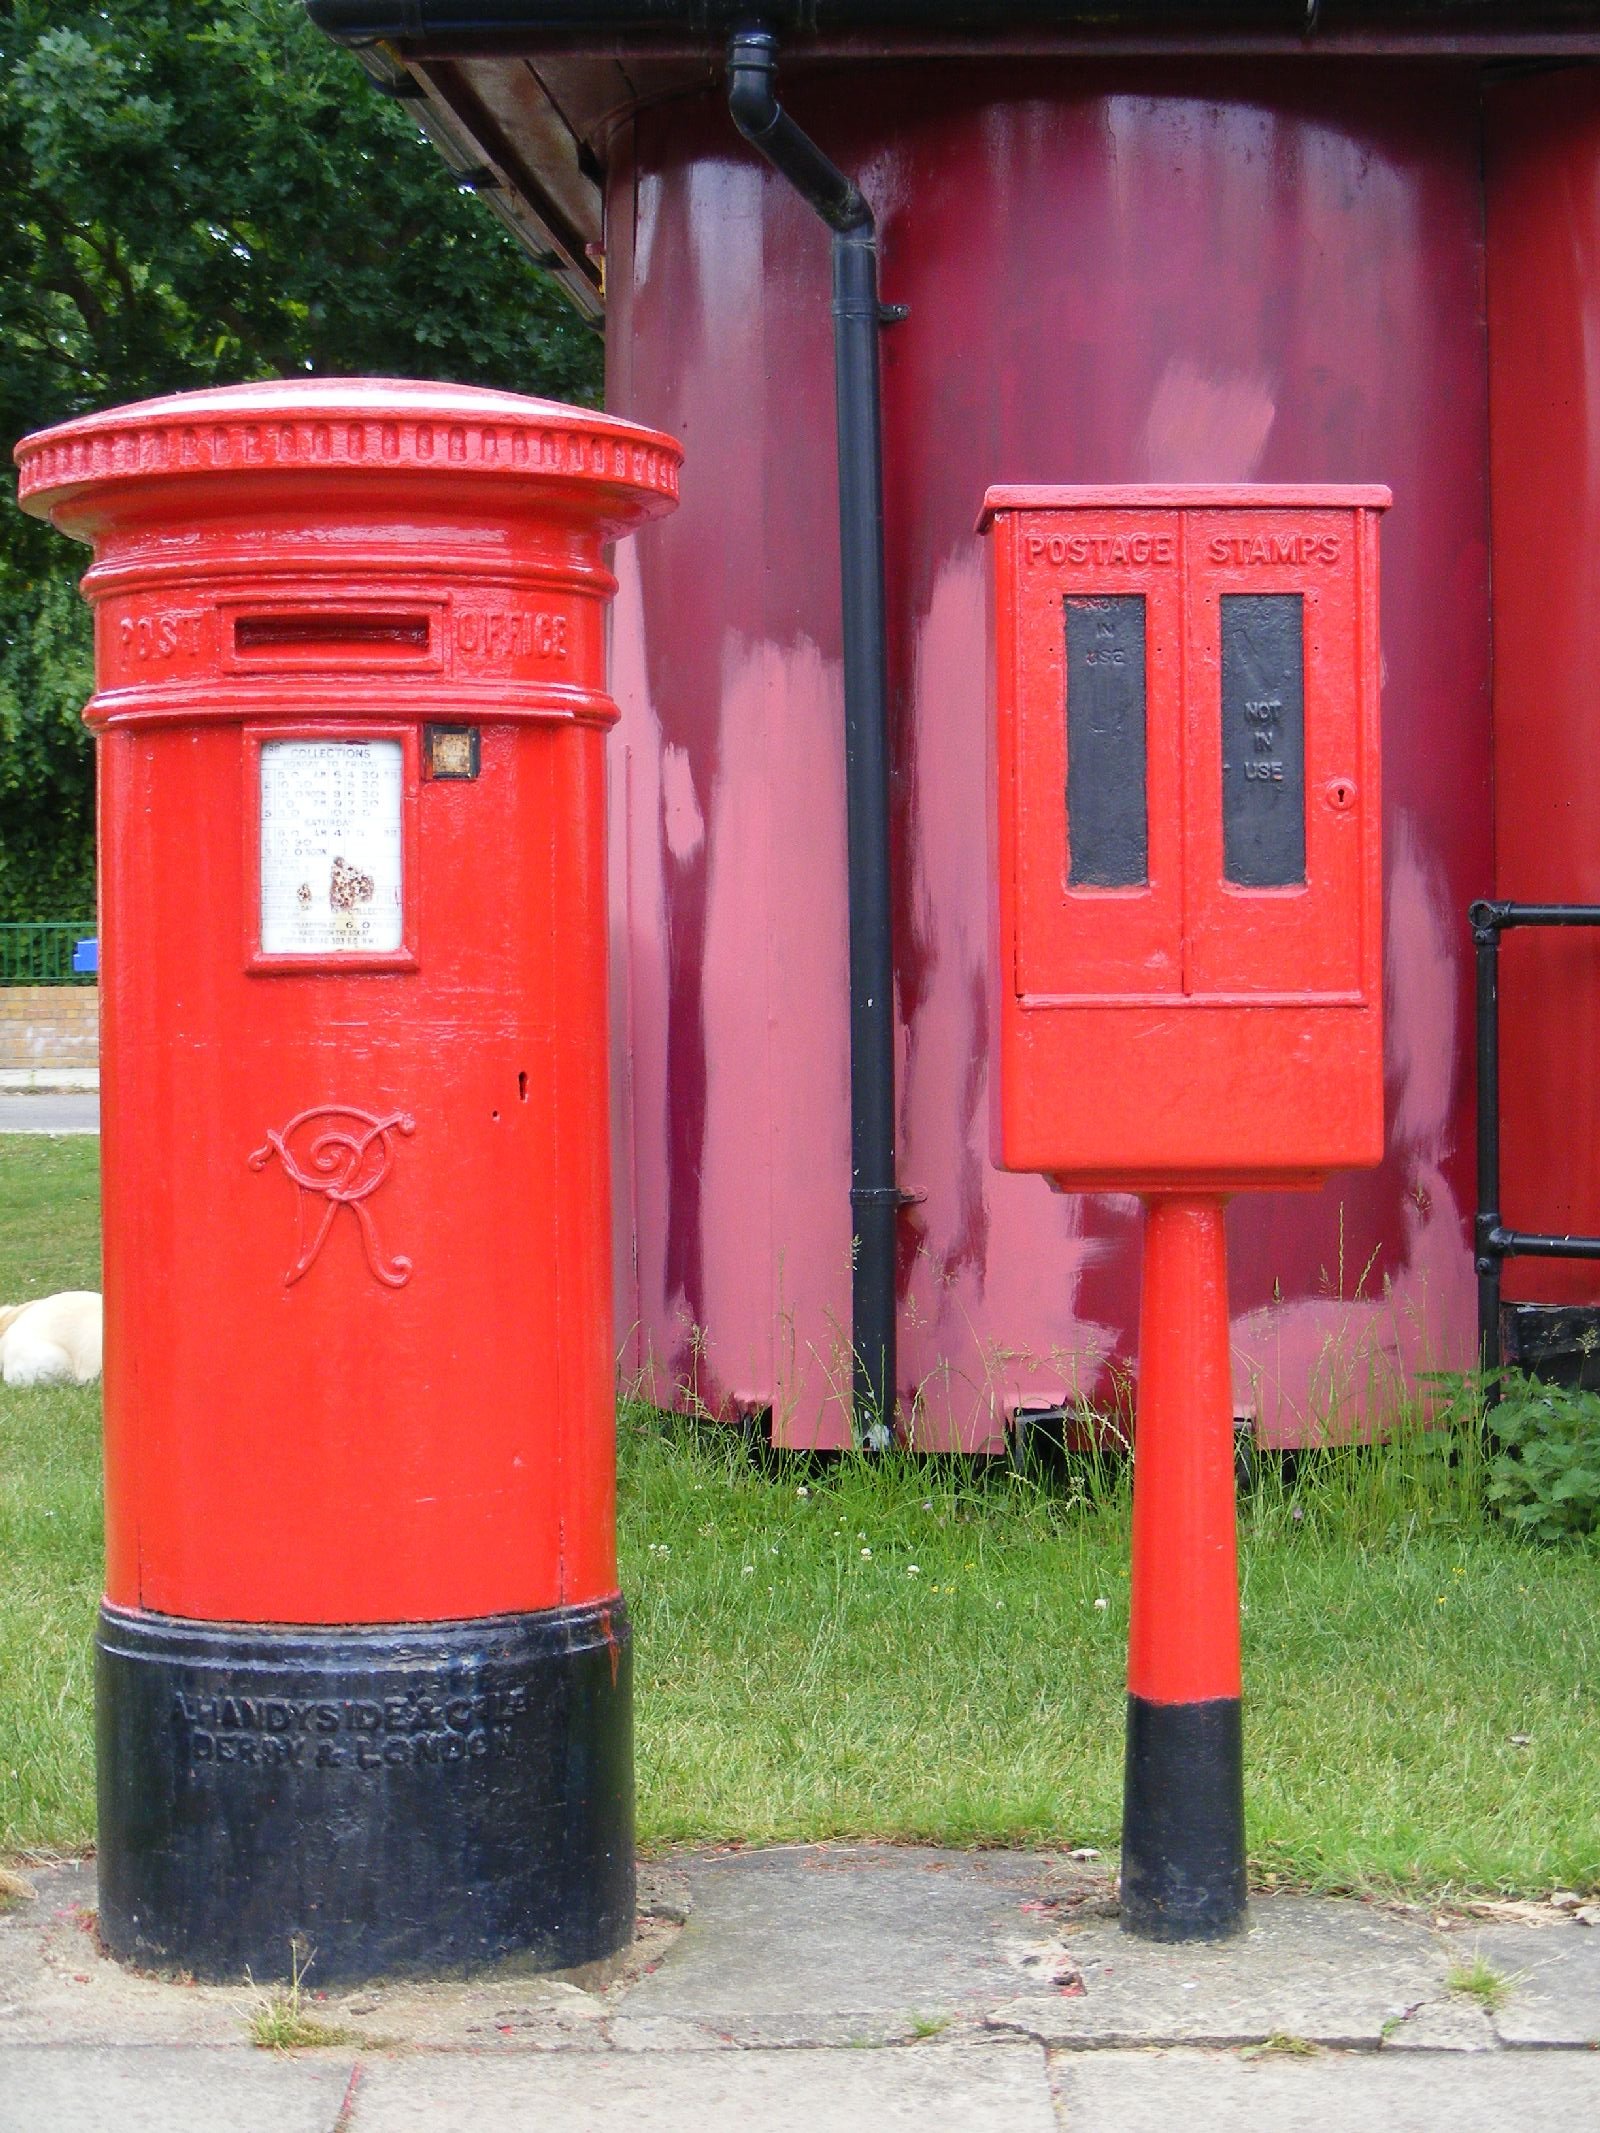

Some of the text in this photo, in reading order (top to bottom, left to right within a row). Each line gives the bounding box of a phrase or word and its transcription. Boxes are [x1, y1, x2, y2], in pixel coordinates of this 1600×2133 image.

[1025, 533, 1341, 565] POSTAGE STAMPS
[119, 610, 568, 663] POST OFFICE
[1244, 700, 1283, 725] NOT
[291, 748, 371, 759] COLLECTIONS
[1254, 731, 1275, 754] IN
[1243, 761, 1284, 783] USE
[191, 1726, 307, 1768] DERBY
[355, 1724, 516, 1770] LONDON
